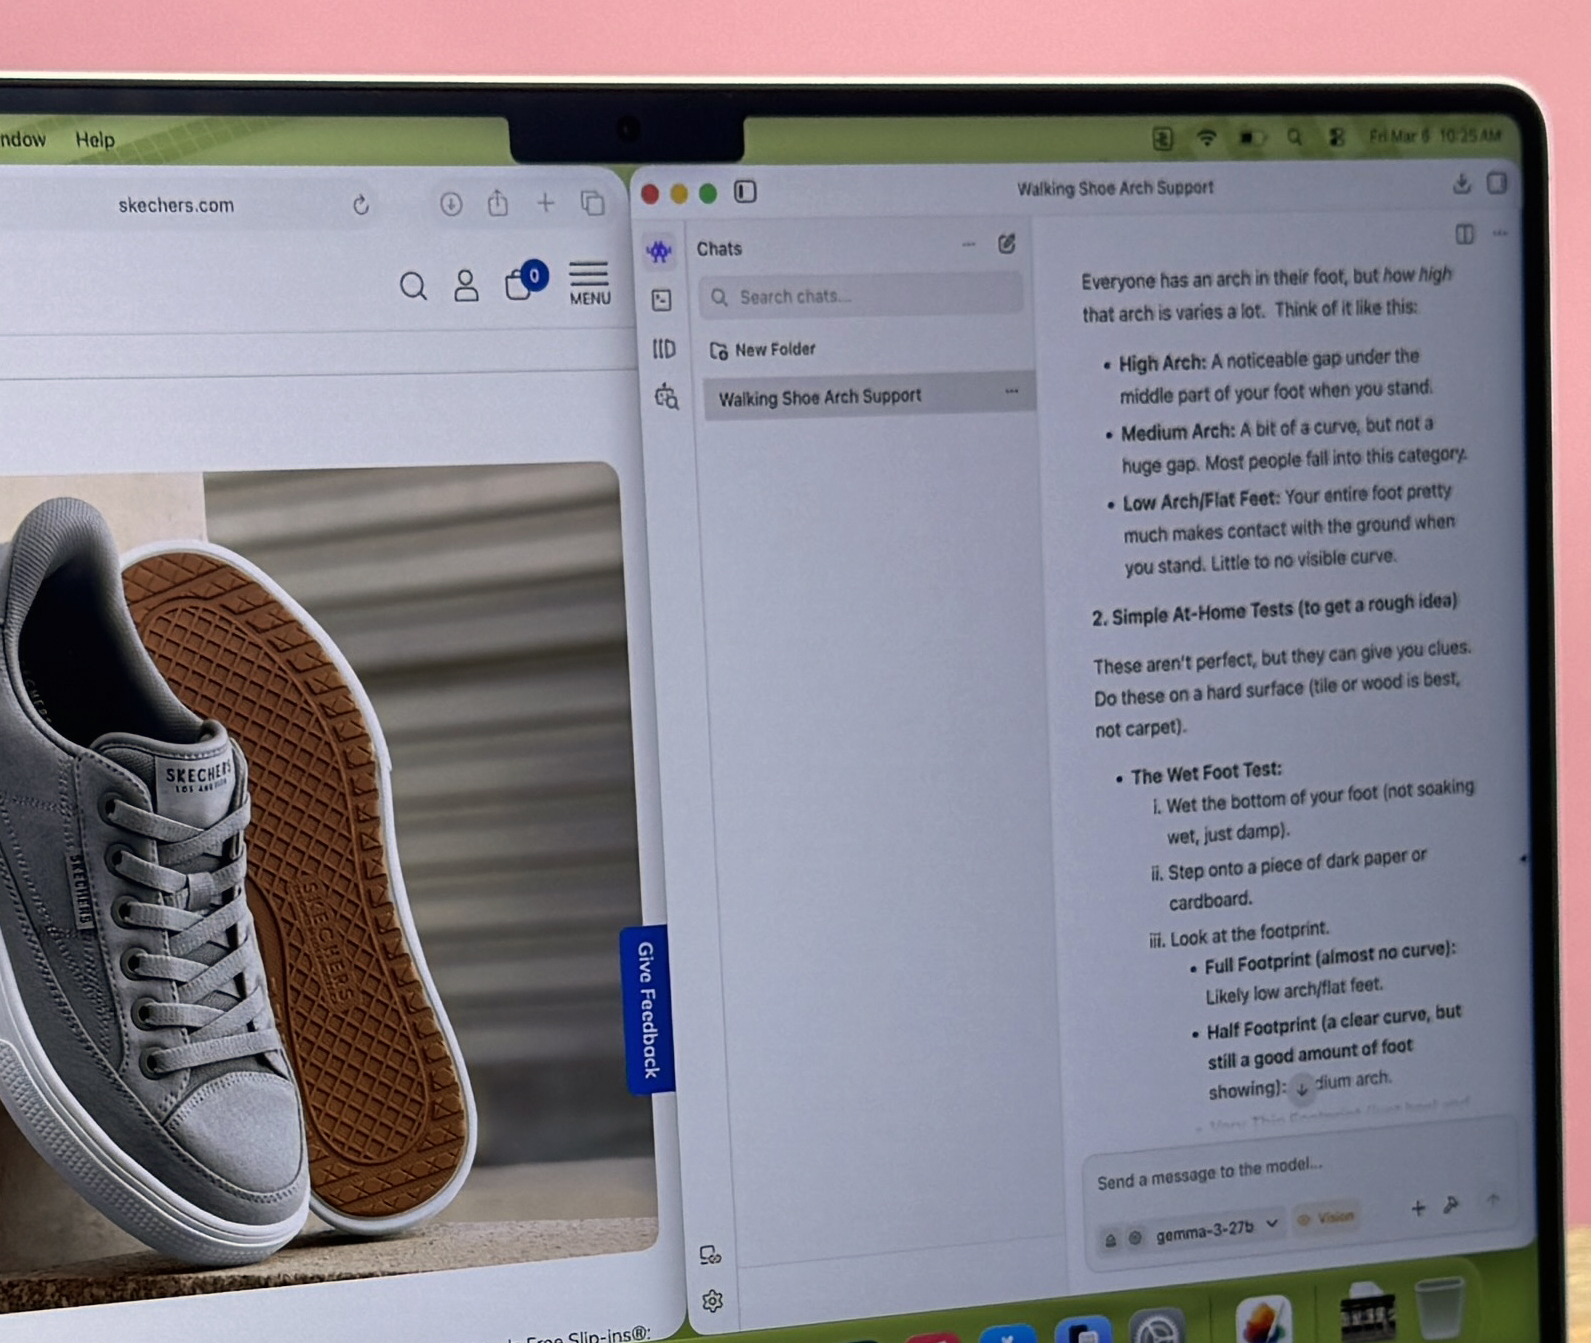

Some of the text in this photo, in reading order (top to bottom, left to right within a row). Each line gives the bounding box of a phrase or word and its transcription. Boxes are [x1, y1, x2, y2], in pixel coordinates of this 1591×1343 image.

[76, 132, 115, 150] Help
[1017, 178, 1214, 199] Walking Shoe Arch Support
[118, 196, 234, 213] skechers.com
[696, 240, 742, 257] Chats
[530, 270, 539, 282] 0
[1081, 265, 1452, 293] Everyone has an arch in their foot, but how high
[570, 292, 611, 305] MENU
[740, 288, 851, 305] Search chats...
[735, 341, 816, 357] New Folder
[1119, 347, 1420, 376] High Arch: A noticeable gap under the
[718, 387, 922, 412] Walking Shoe Arch Support
[1092, 591, 1458, 628] 2. Simple At-Home Tests (to get a rough idea)
[1092, 639, 1471, 675] These aren't perfect, but they can give you clues.
[166, 759, 231, 783] SKECHERS
[1130, 761, 1282, 785] The Wet Foot Test:
[1204, 939, 1456, 975] Full Footprint (almost no curve):
[638, 942, 660, 1079] Give Feedback
[1208, 1038, 1414, 1070] still a good amount of foot
[1097, 1155, 1322, 1191] Send a message to the model...
[1317, 1211, 1355, 1224] Vision
[1156, 1219, 1254, 1246] gemma-3-27b
